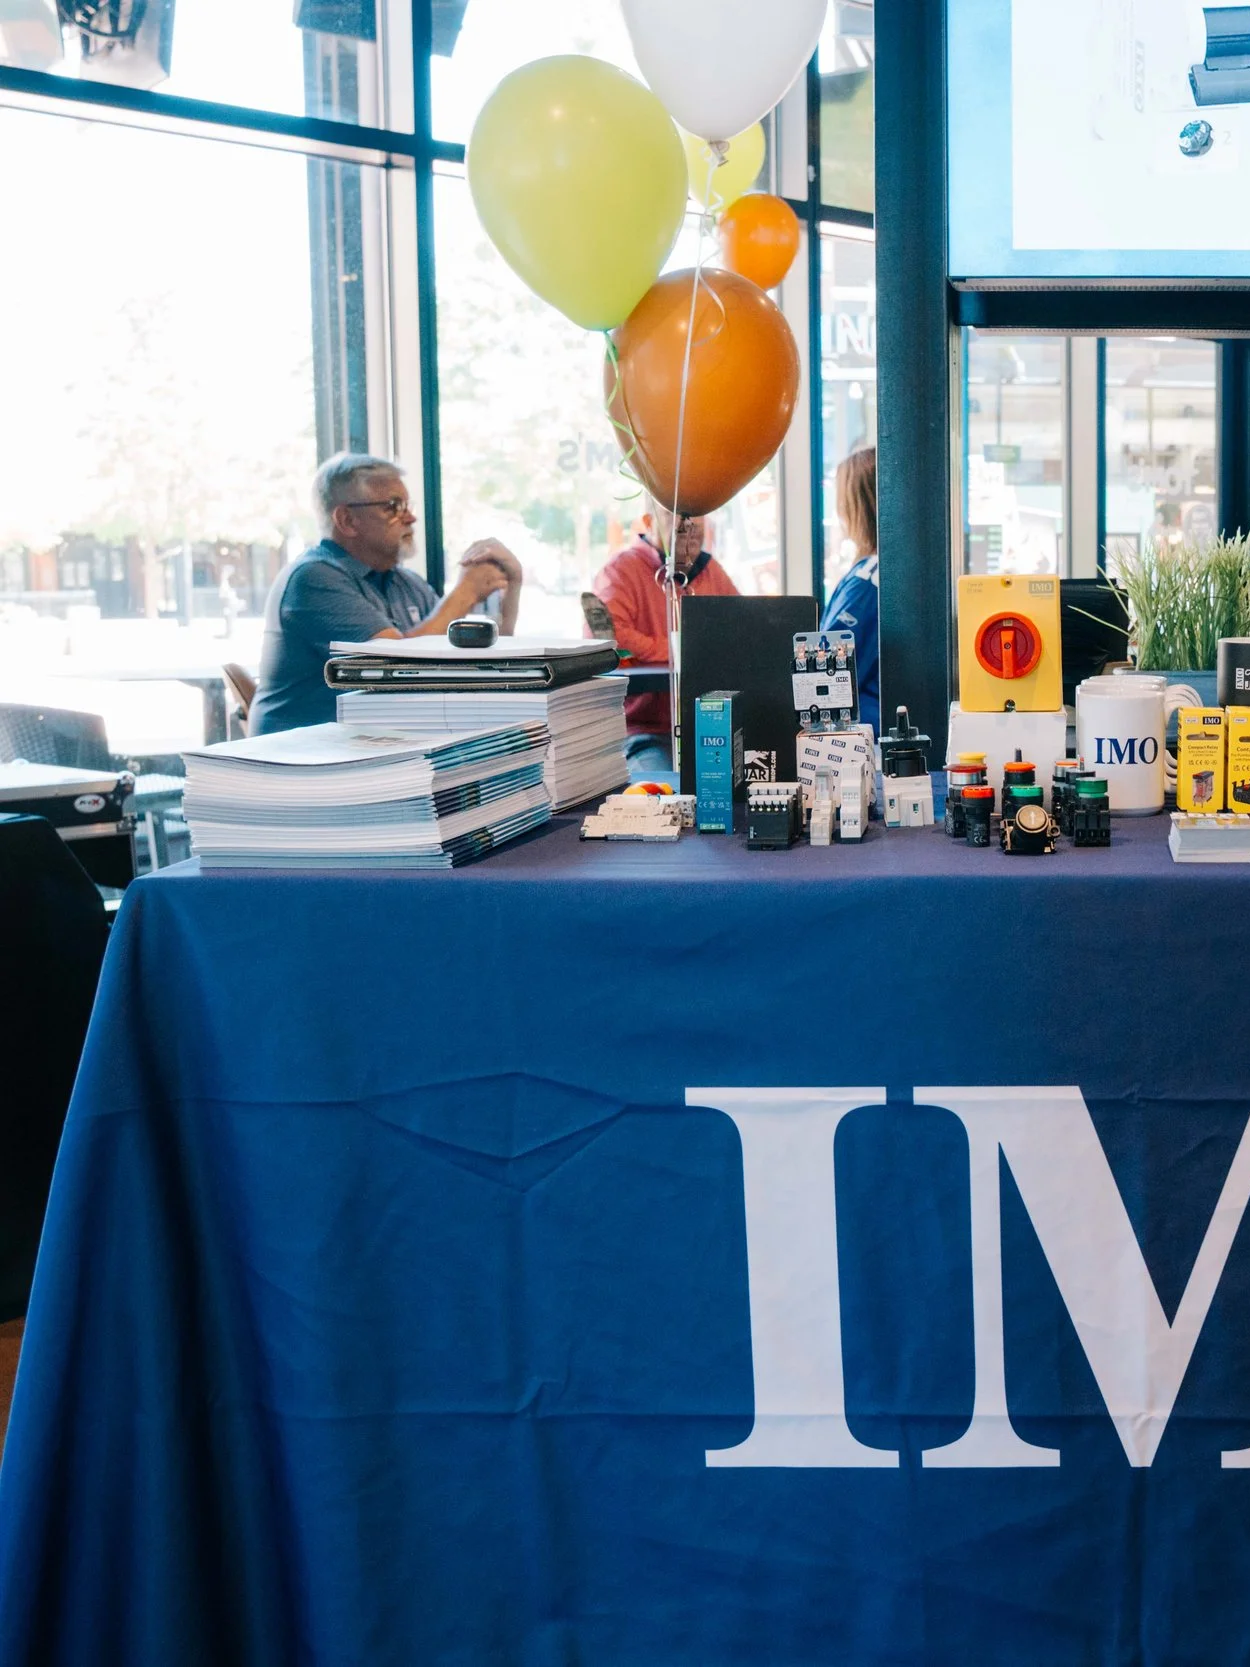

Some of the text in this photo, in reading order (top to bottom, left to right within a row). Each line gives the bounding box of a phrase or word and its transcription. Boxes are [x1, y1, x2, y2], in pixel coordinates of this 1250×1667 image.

[1031, 582, 1052, 591] IMO
[703, 737, 725, 746] IMO
[1094, 736, 1158, 765] IMO
